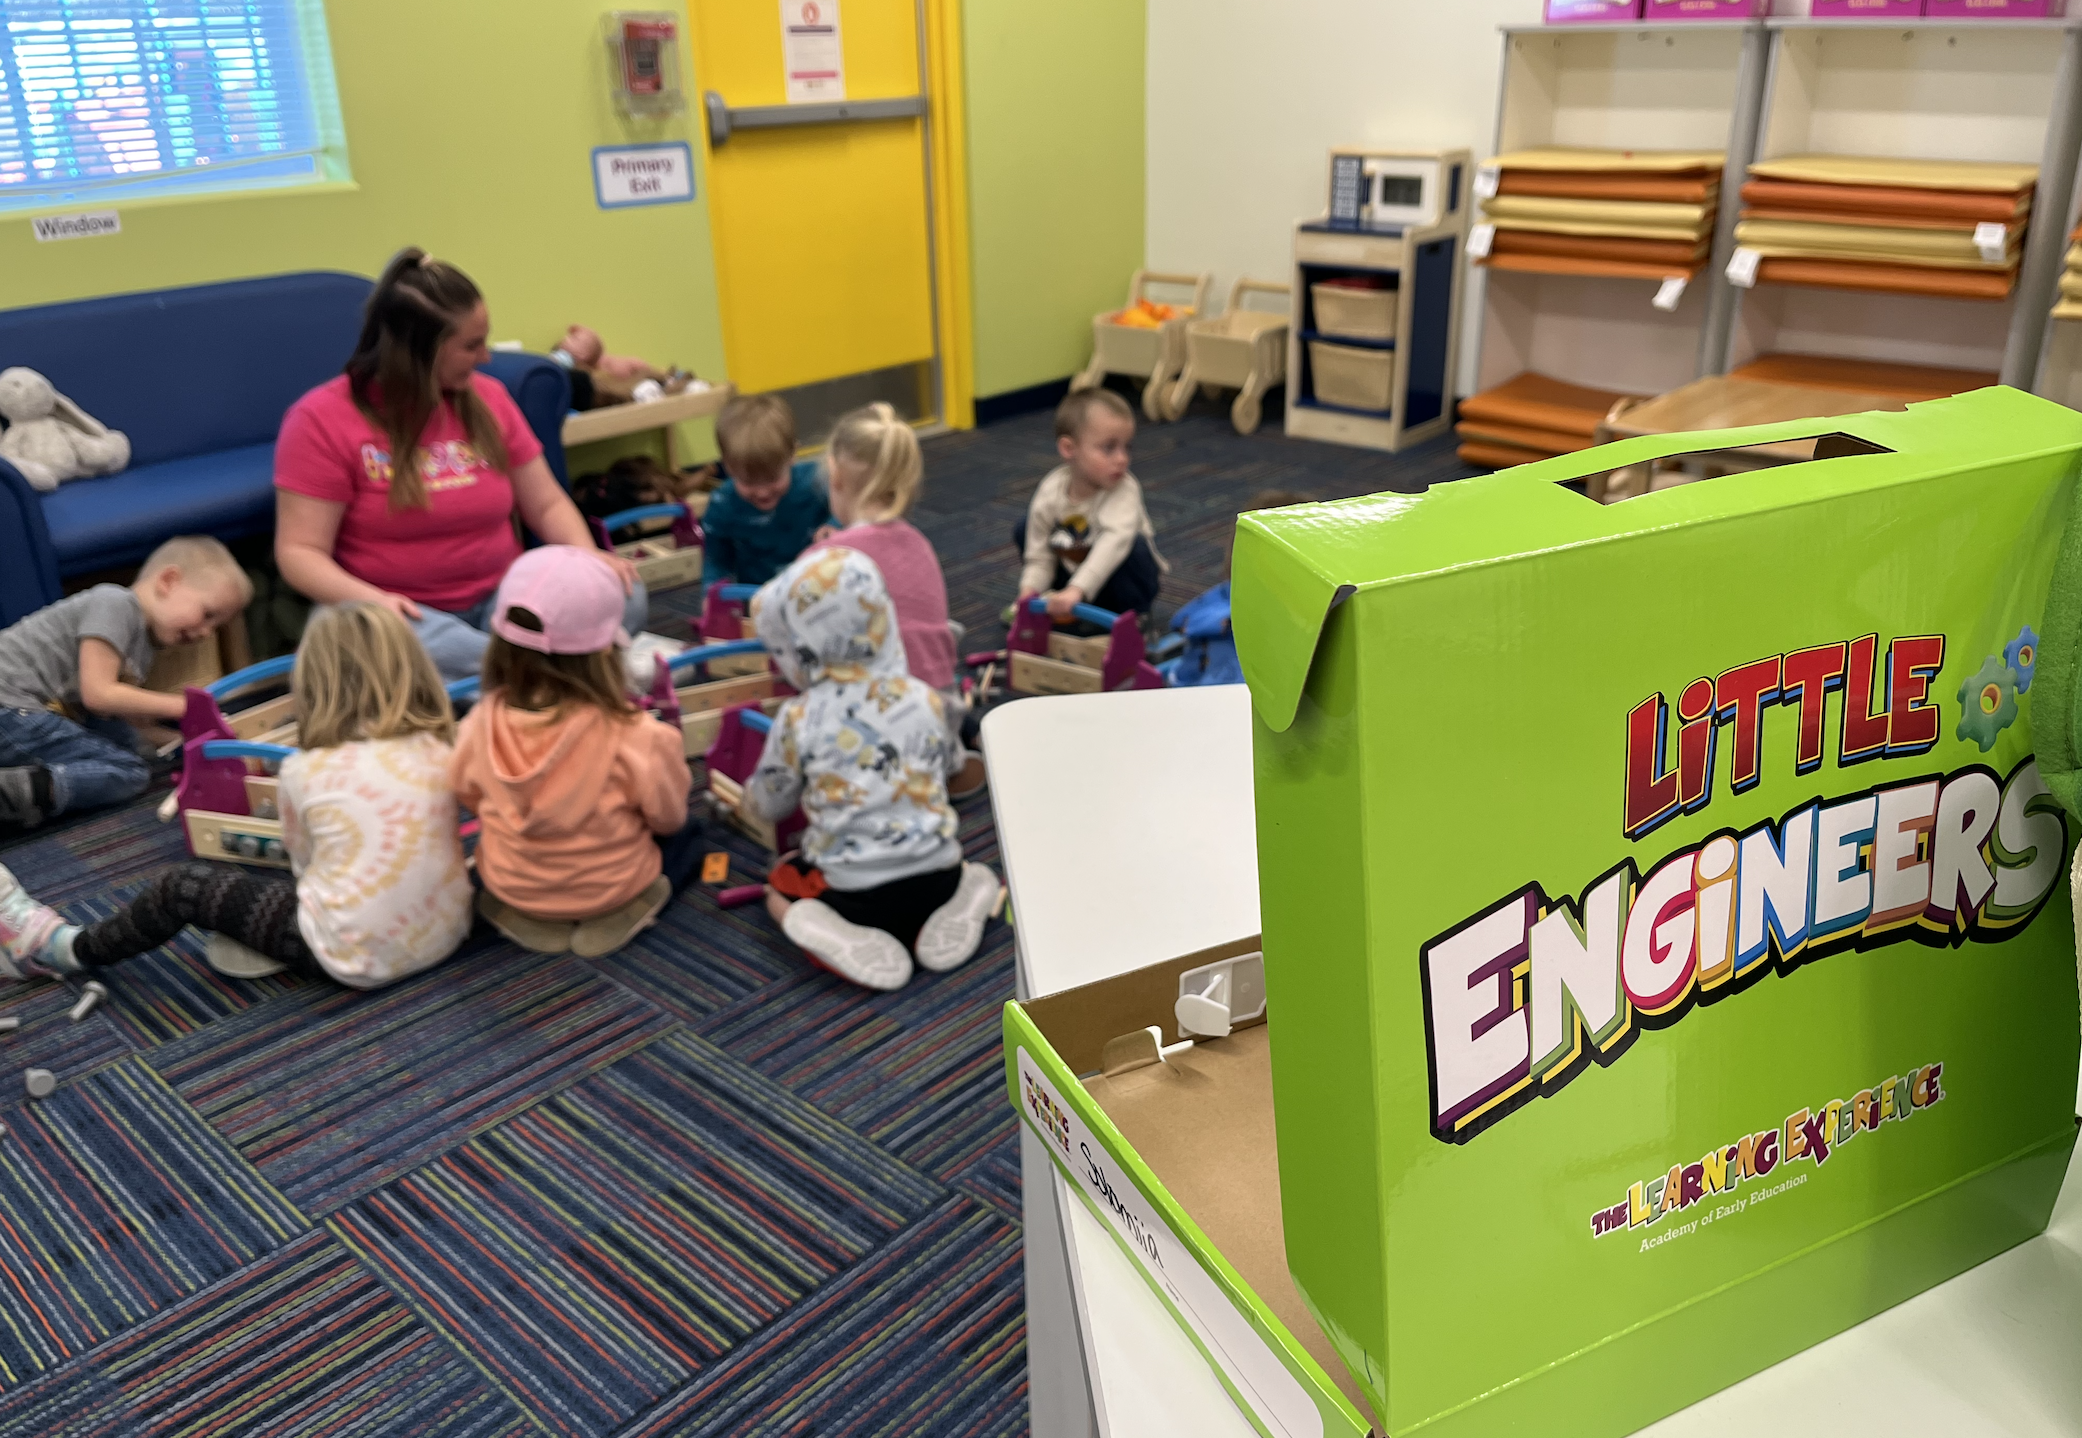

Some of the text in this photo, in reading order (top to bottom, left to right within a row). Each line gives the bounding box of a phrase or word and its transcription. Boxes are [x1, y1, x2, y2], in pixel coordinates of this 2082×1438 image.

[610, 157, 674, 176] Primary
[628, 176, 662, 194] Exit
[35, 214, 116, 238] Window
[1589, 1201, 1630, 1239] THE
[1638, 1172, 1808, 1253] Academy of Early Education
